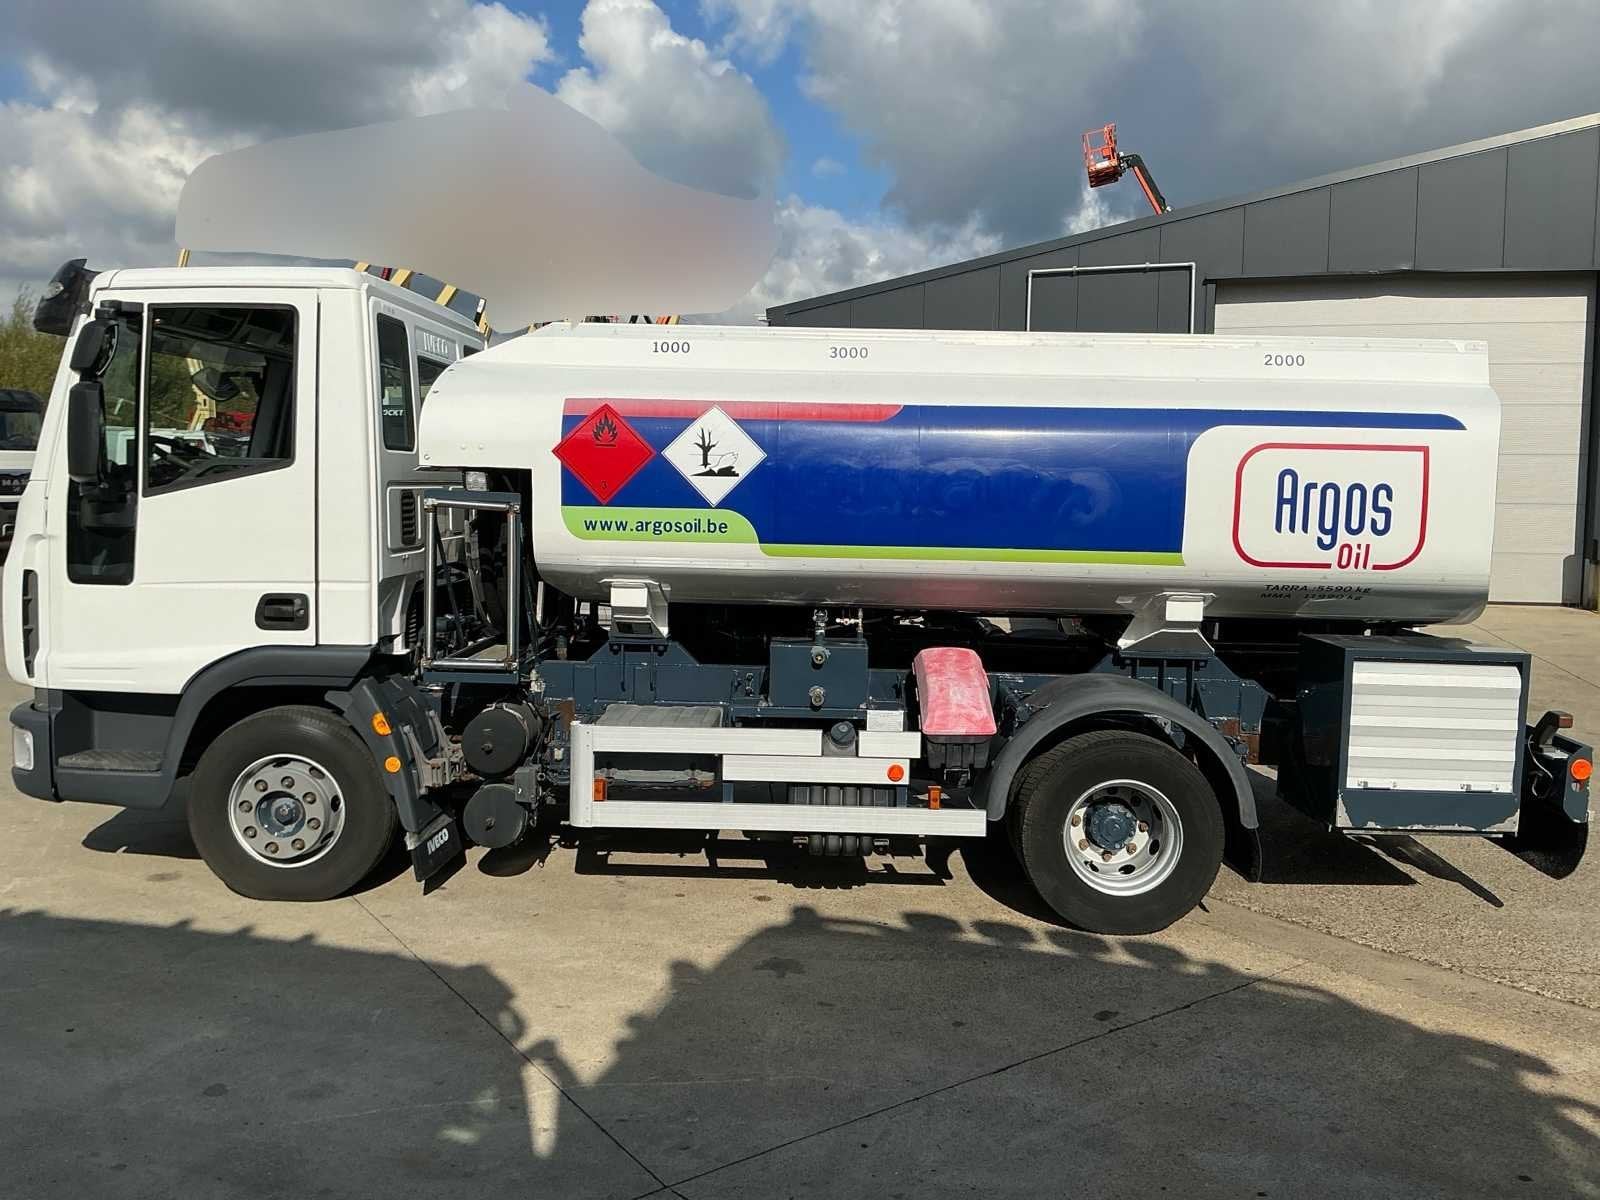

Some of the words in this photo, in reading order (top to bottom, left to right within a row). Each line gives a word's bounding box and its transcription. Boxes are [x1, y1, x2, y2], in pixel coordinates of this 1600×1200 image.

[652, 341, 691, 354] 1000
[829, 346, 869, 359] 3000
[1263, 353, 1306, 367] 2000
[601, 481, 608, 490] 3
[1275, 468, 1393, 551] Argos
[583, 518, 729, 536] www.argosoil.be
[1337, 543, 1371, 570] Oil
[1264, 584, 1308, 592] TARRA
[427, 828, 449, 855] IVECO
